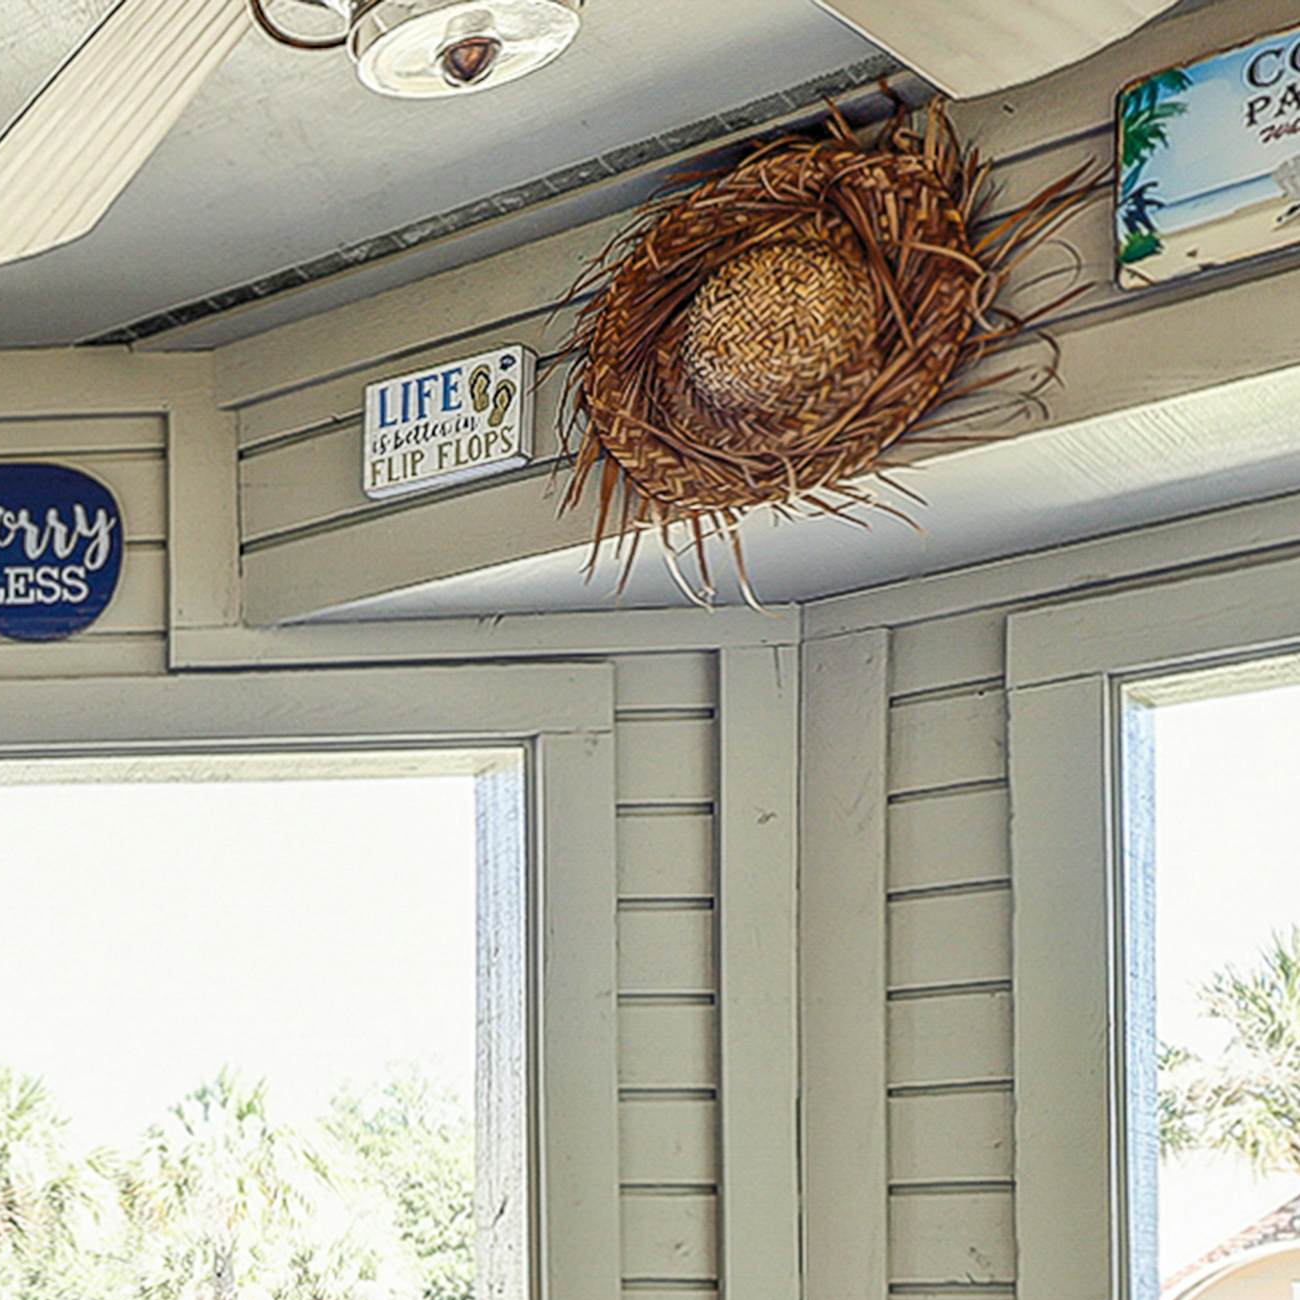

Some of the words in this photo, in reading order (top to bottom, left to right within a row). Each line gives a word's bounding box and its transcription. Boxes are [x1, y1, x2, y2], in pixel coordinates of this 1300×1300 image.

[378, 367, 463, 429] LIFE
[370, 449, 425, 487] FLIP
[438, 425, 514, 470] FLOPS
